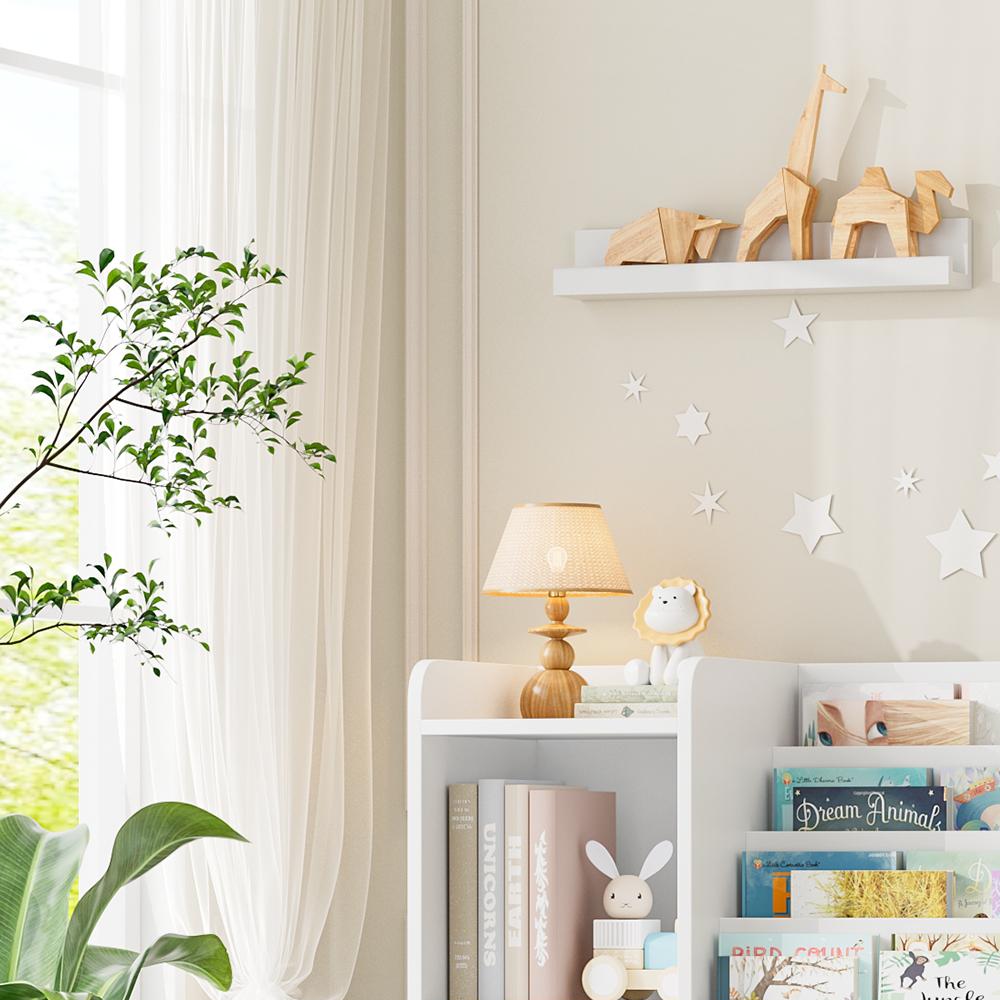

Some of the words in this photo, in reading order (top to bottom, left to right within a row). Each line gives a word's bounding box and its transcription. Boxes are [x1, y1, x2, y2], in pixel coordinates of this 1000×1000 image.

[796, 797, 863, 831] Dream
[866, 791, 942, 831] Animals
[483, 822, 497, 967] UNICORNS
[507, 834, 522, 947] EARTH
[935, 976, 967, 990] The
